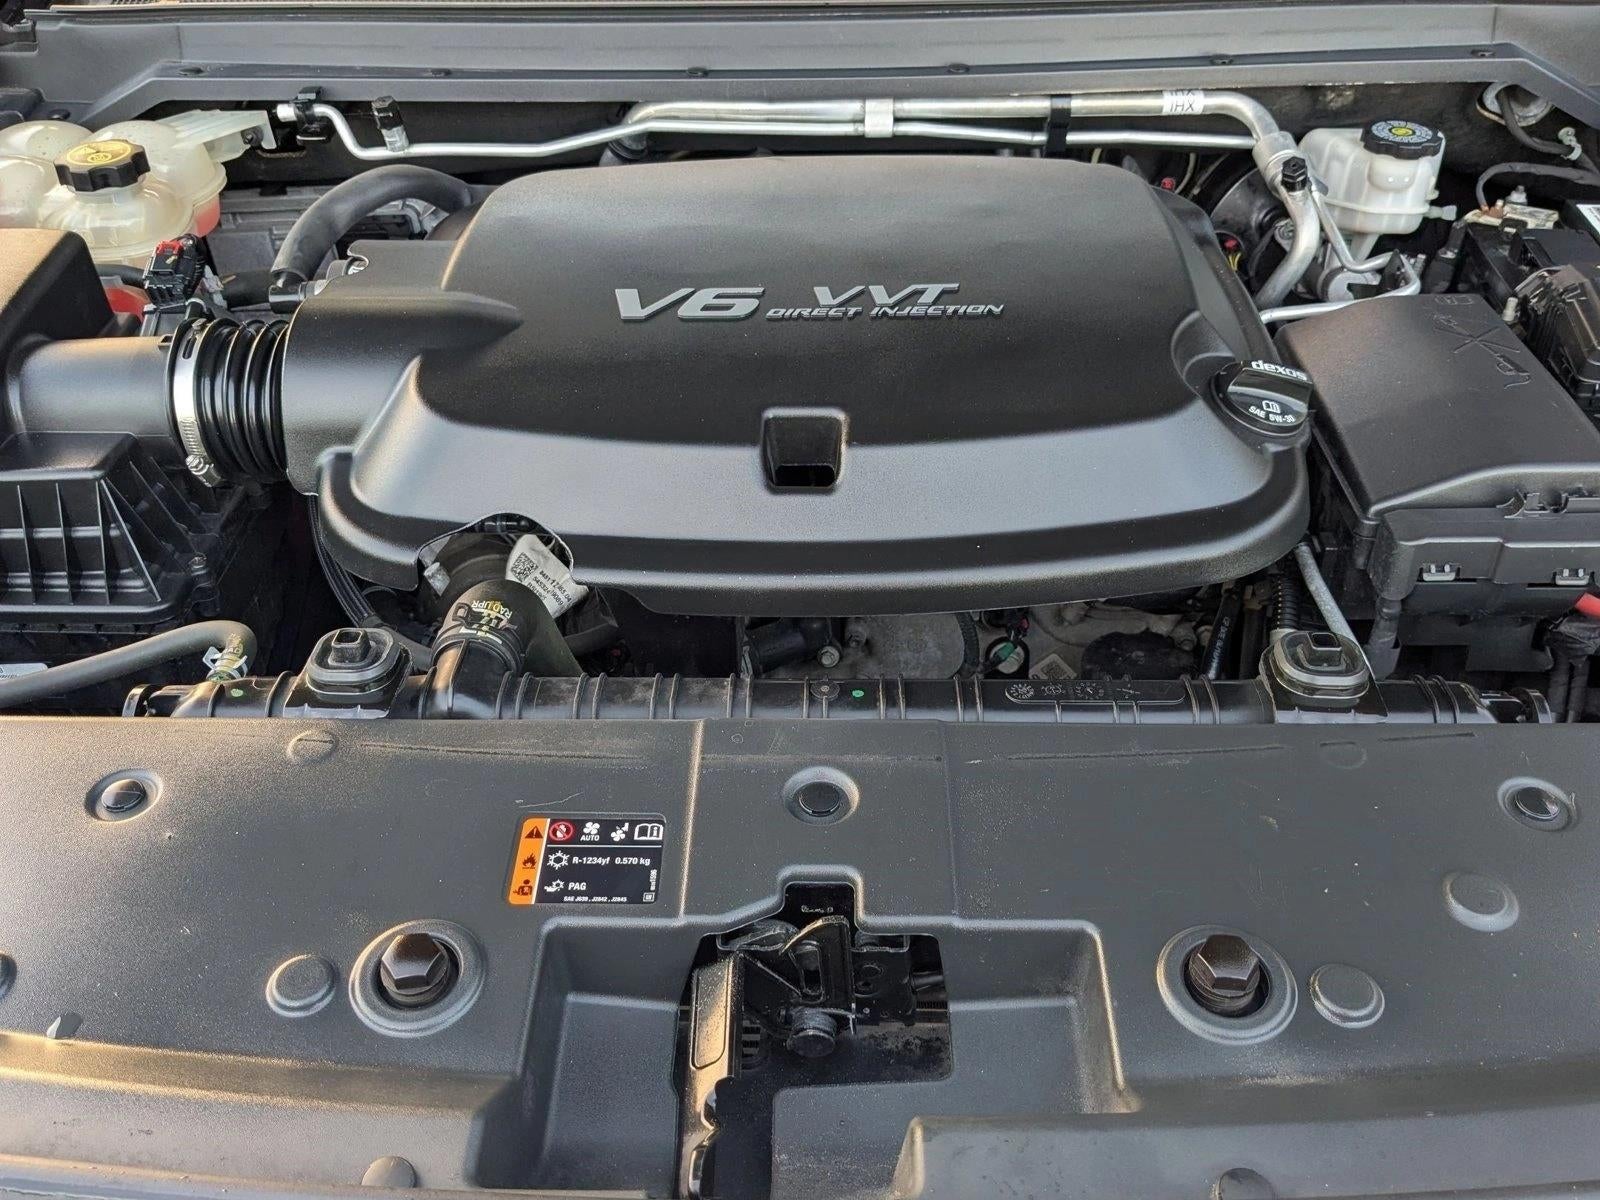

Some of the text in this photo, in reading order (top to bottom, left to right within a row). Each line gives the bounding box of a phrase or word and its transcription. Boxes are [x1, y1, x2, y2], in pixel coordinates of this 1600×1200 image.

[813, 283, 960, 306] VVT
[614, 287, 765, 320] V6
[765, 304, 1004, 320] DIRECT INJECTION
[1251, 360, 1307, 381] dexos
[1248, 405, 1266, 418] SAE
[492, 602, 513, 618] RAD
[572, 856, 650, 866] R-1234yf 0.570 kg
[568, 882, 587, 891] PAG
